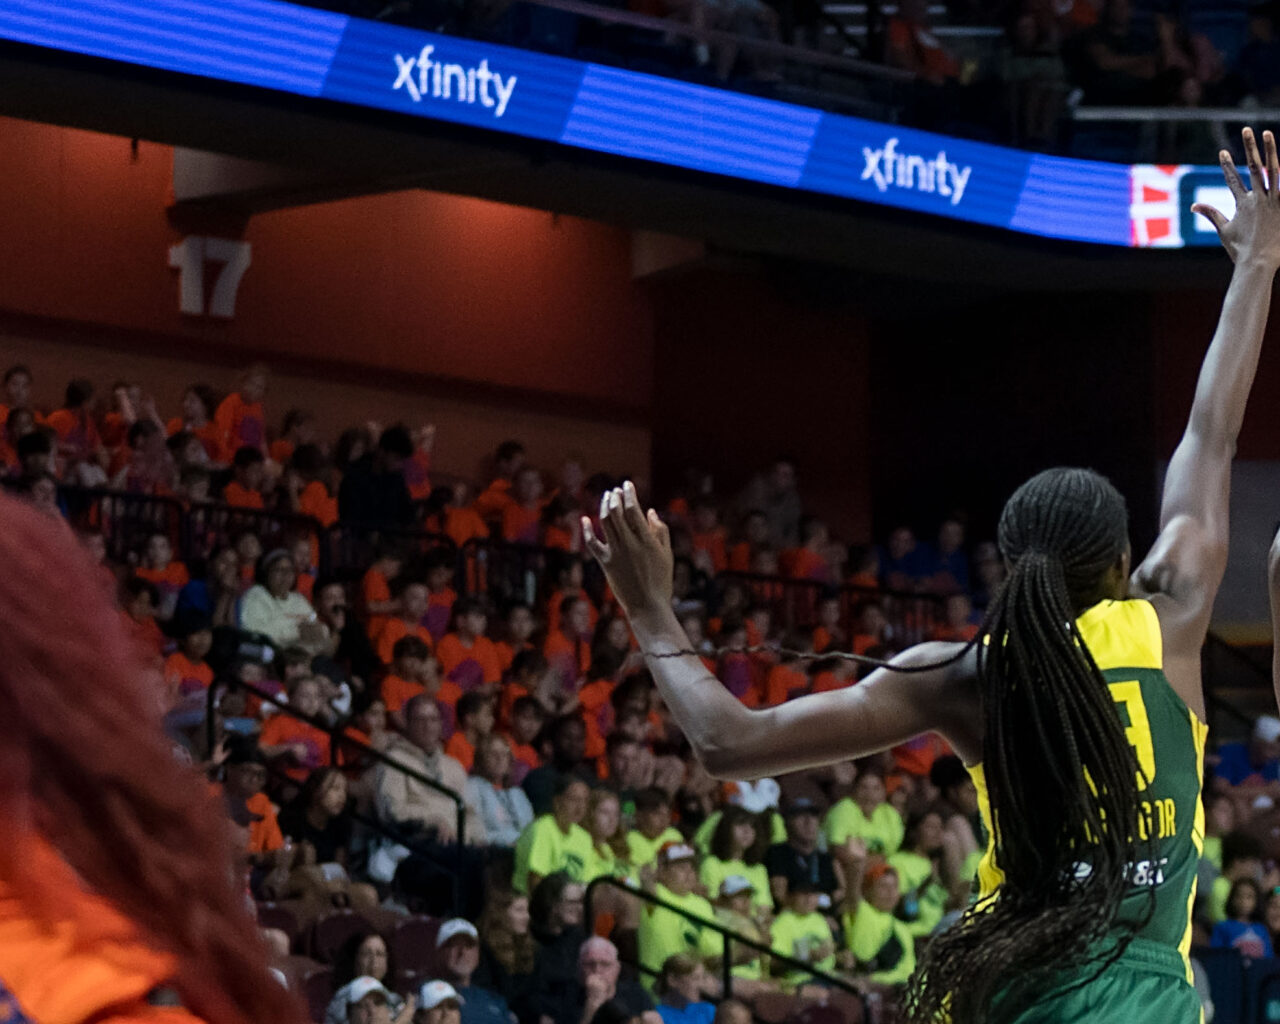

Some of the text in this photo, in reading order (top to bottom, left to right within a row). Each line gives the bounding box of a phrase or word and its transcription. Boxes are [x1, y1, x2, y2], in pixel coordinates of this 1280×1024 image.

[393, 44, 518, 118] xfinity
[860, 137, 972, 206] xfinity
[168, 235, 252, 317] 17
